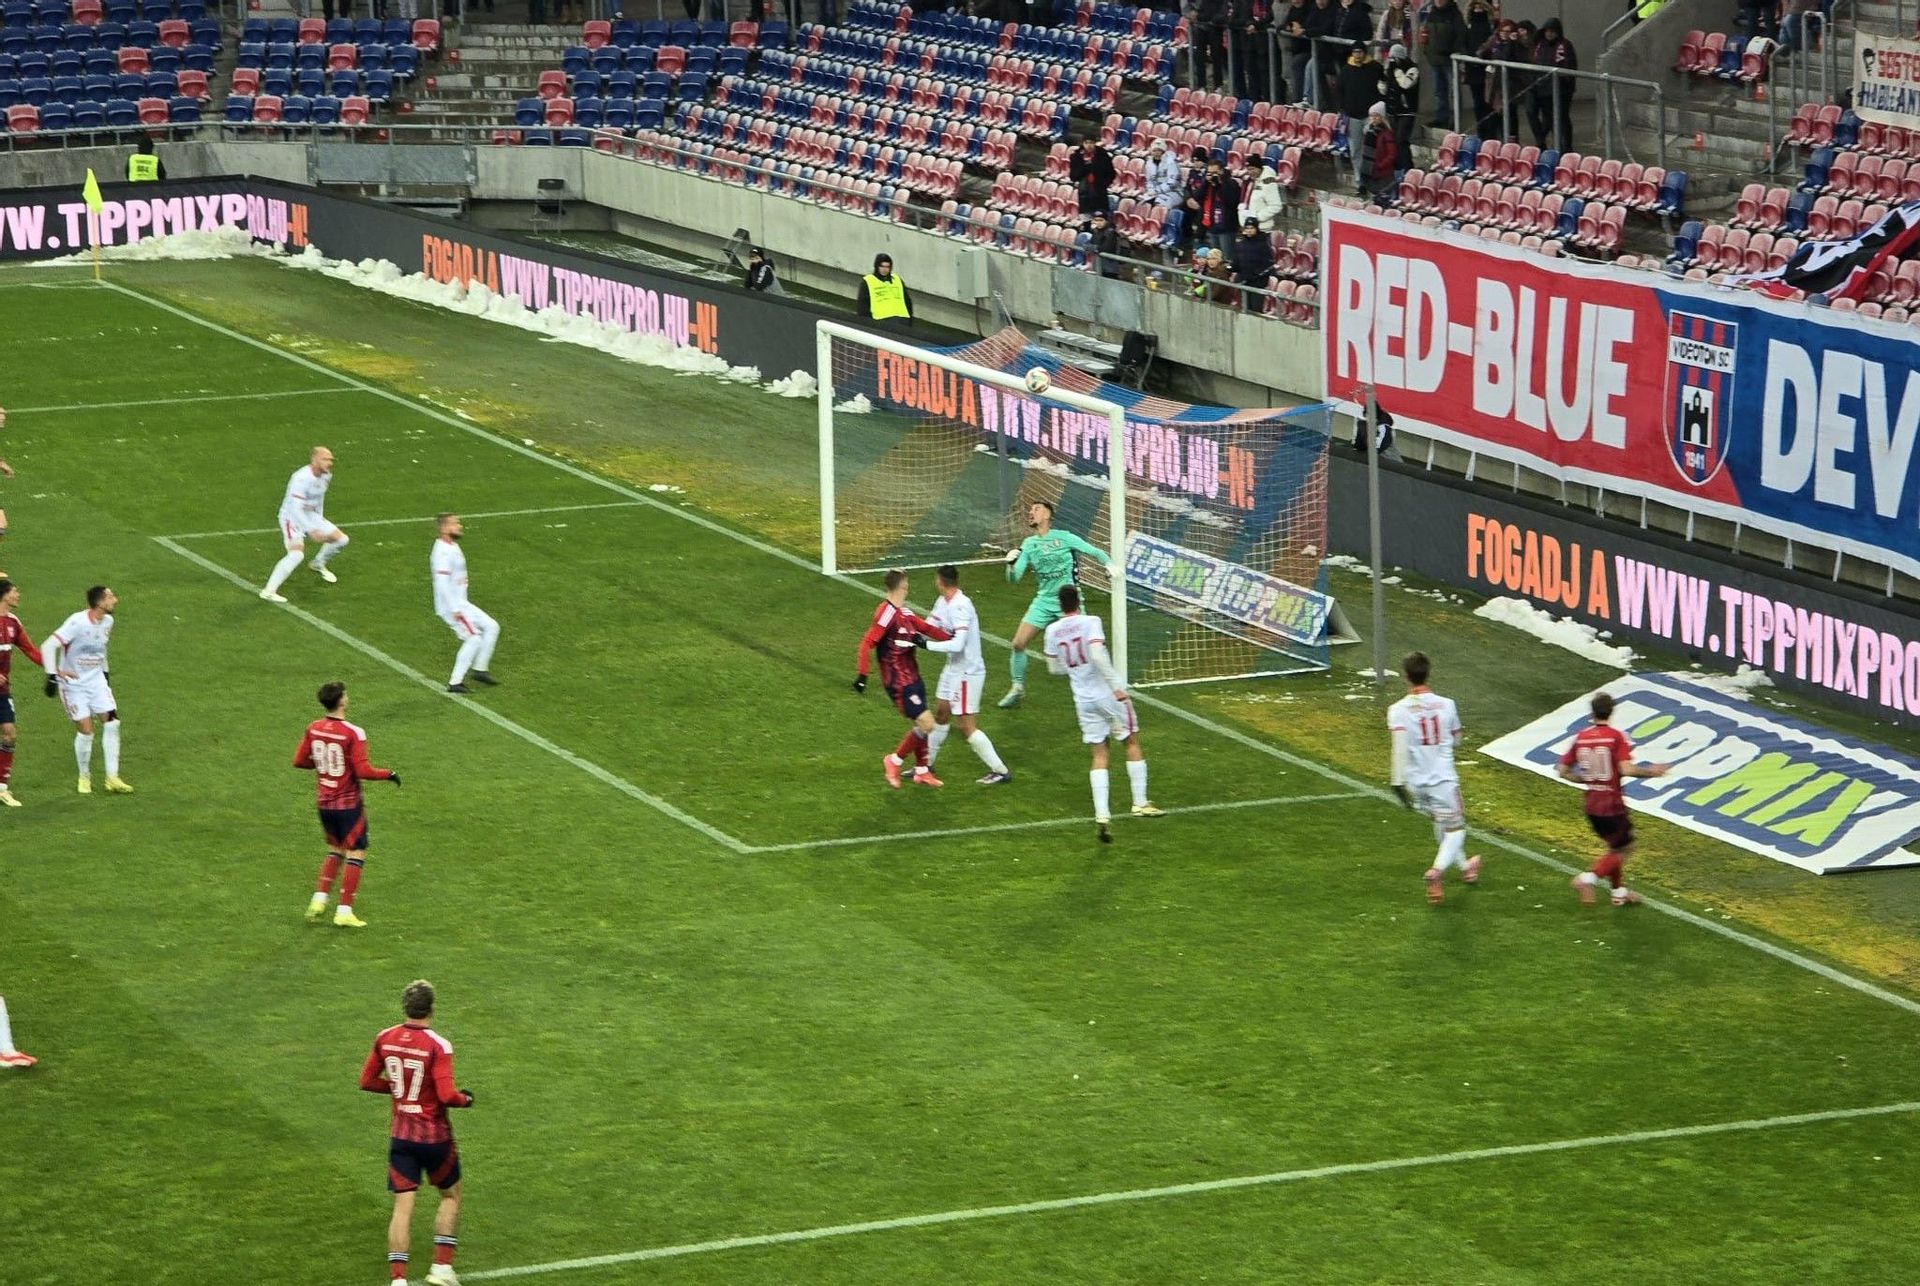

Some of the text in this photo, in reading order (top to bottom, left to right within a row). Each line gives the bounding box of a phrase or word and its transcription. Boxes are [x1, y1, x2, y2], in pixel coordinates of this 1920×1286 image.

[487, 251, 499, 292] A
[500, 254, 718, 354] WWWTIPPMIXPROHU-N!
[1672, 340, 1730, 367] VIDEOTON SC
[961, 379, 977, 426] A
[1337, 244, 1920, 524] RED-BLUE DEV
[1467, 513, 1581, 609] FOGADJ
[1587, 549, 1610, 619] A
[1418, 714, 1440, 746] 11
[384, 1055, 424, 1101] 97
